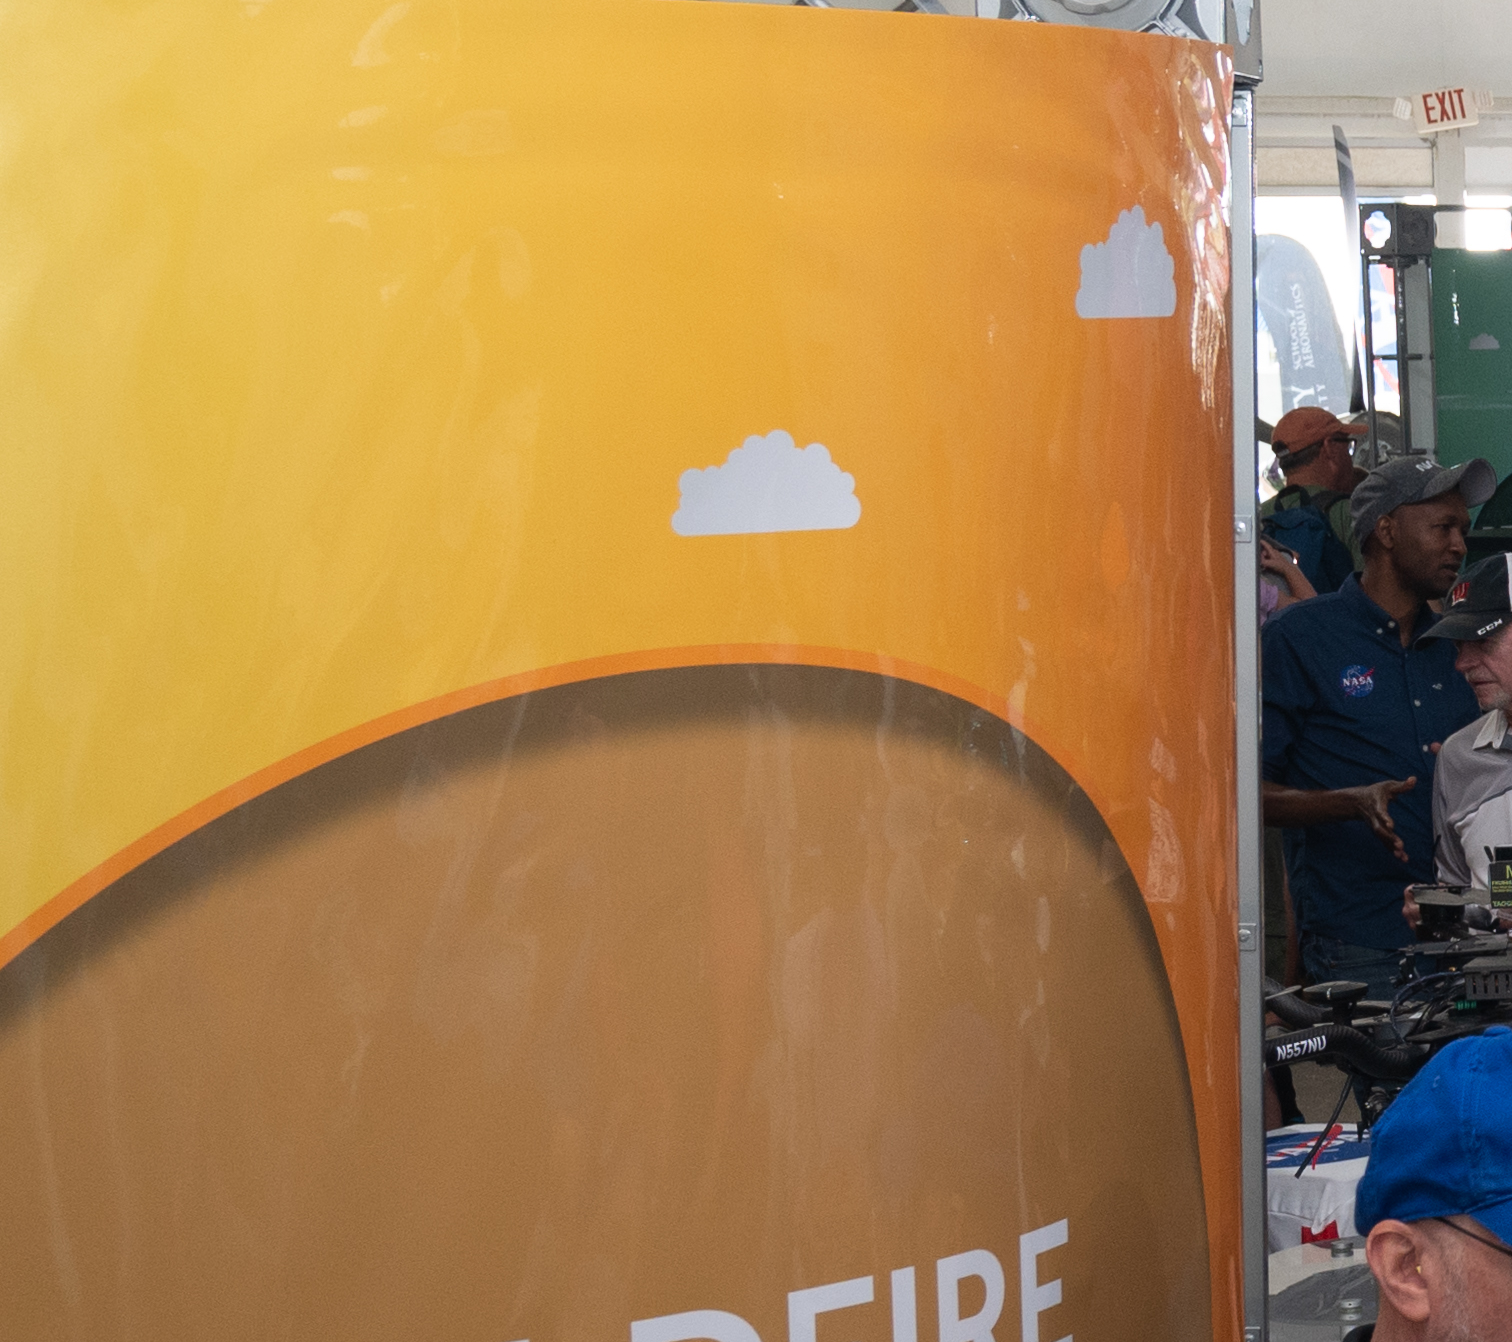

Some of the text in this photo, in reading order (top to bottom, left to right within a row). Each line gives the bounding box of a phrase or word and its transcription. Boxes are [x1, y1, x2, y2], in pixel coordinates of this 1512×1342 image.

[1422, 88, 1466, 125] EXIT
[1477, 617, 1502, 636] CCM
[1342, 675, 1373, 686] NASA
[1277, 1035, 1327, 1061] N557NU
